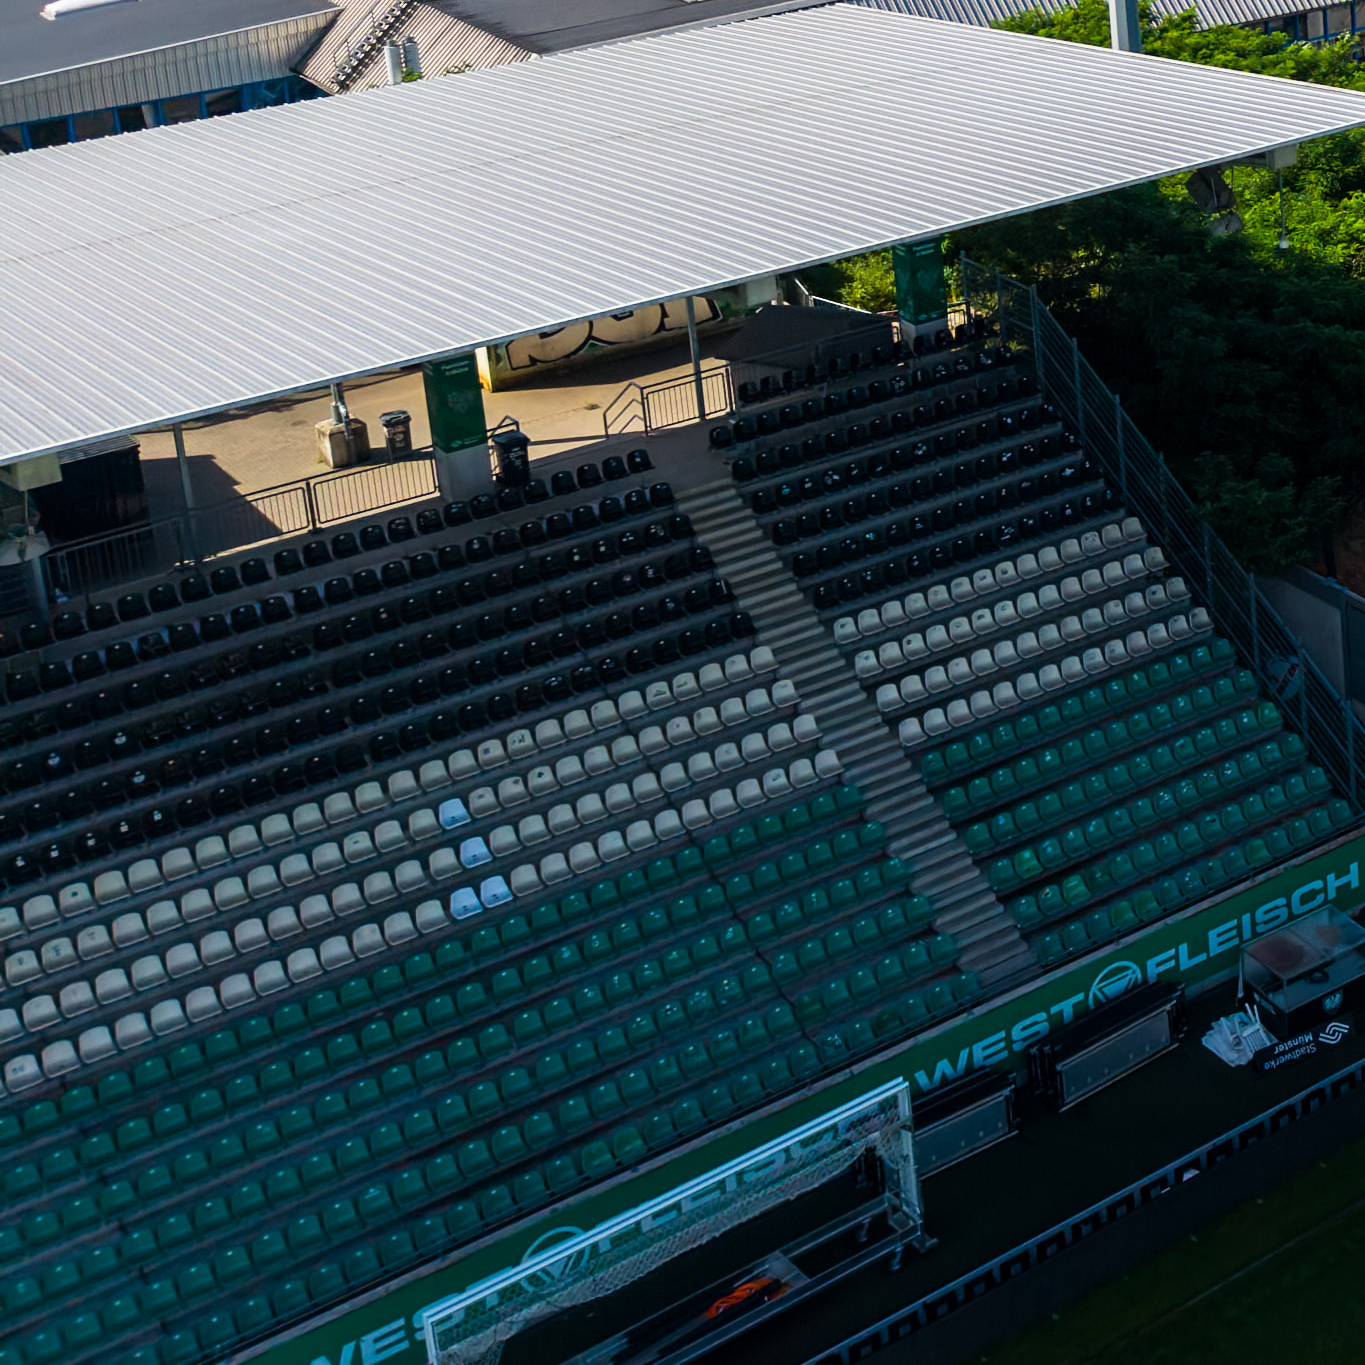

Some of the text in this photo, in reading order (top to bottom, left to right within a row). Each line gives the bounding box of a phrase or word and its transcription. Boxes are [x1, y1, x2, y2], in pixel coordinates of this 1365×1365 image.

[913, 861, 1360, 1093] WEST FLEISCH
[1264, 1042, 1317, 1070] Stadtwerke
